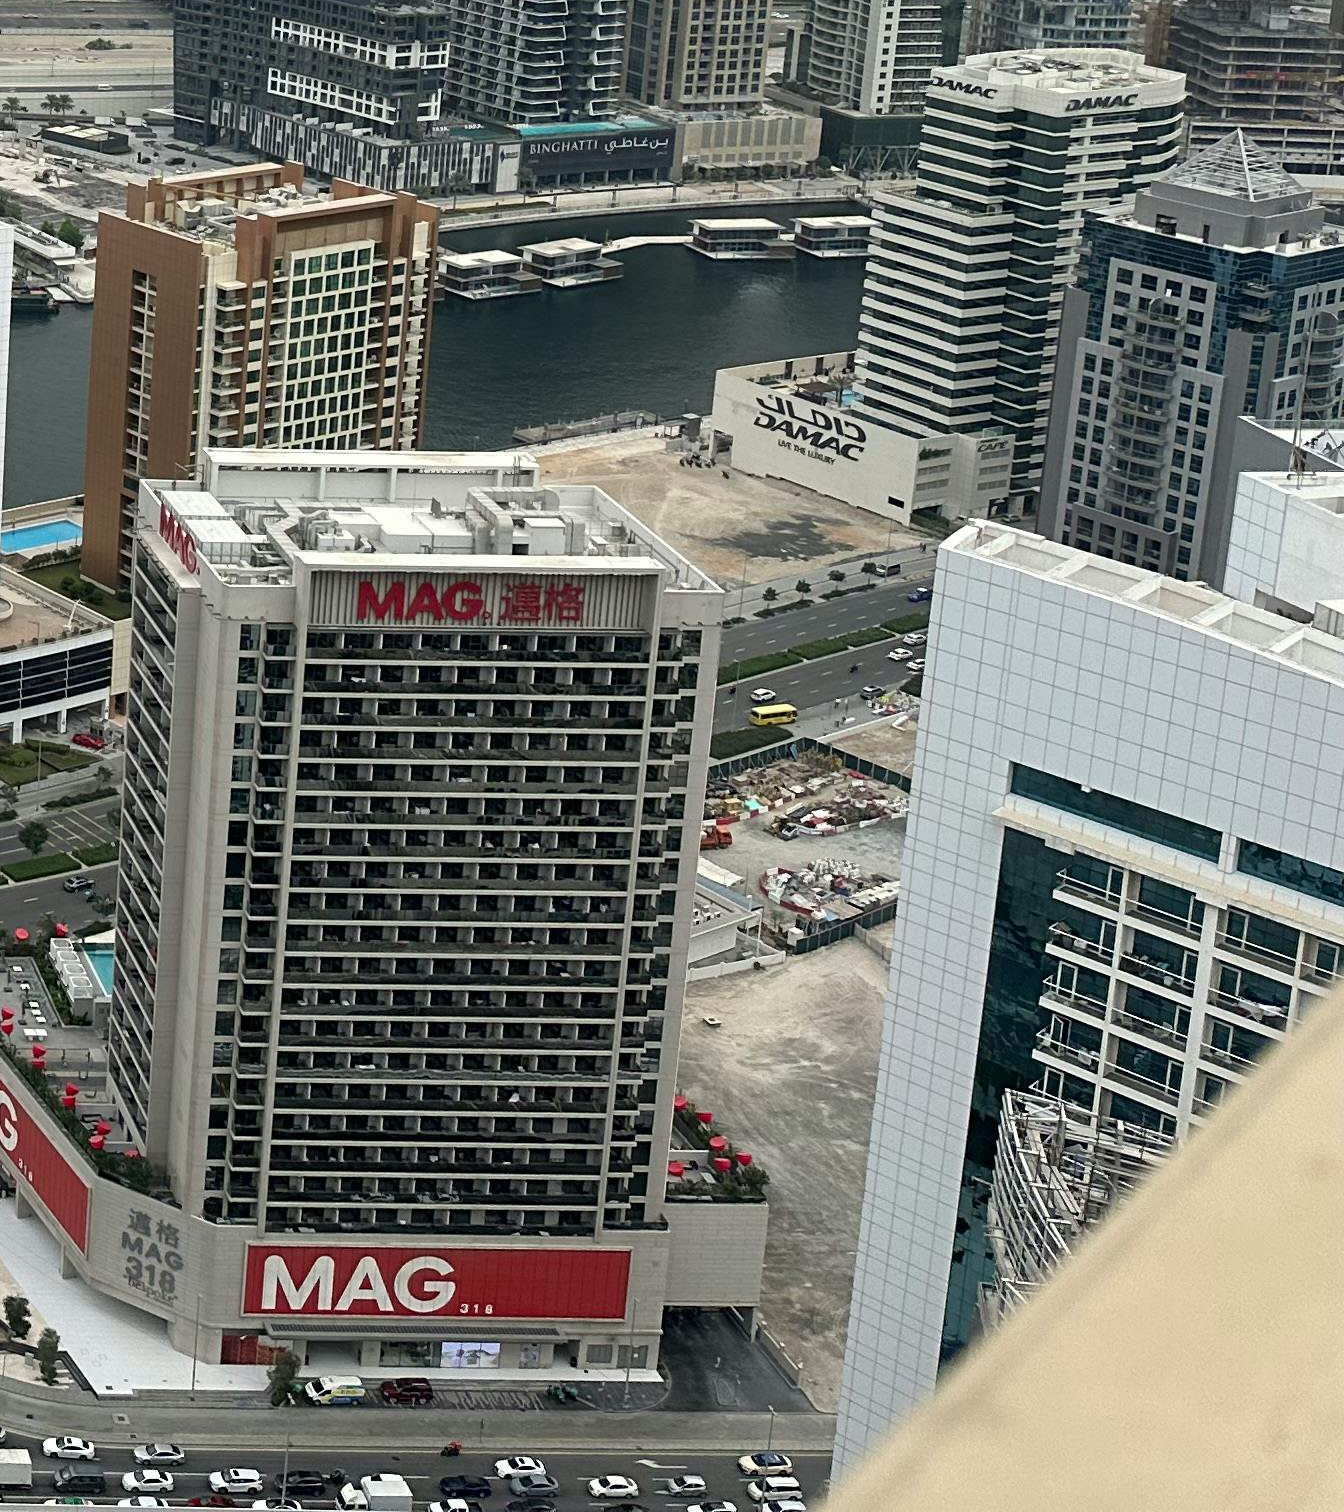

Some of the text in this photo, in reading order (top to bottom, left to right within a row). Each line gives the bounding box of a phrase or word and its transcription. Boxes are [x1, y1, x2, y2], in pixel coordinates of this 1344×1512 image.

[928, 76, 998, 100] DAMAC
[1064, 93, 1139, 113] DAMAC
[529, 139, 599, 155] BINGHATTI
[753, 411, 864, 462] DAMAC
[777, 439, 792, 450] LIVE
[793, 444, 806, 455] THE
[122, 1232, 184, 1271] MAG
[125, 1256, 176, 1294] 318
[262, 1255, 457, 1313] MAG
[460, 1303, 493, 1314] 318
